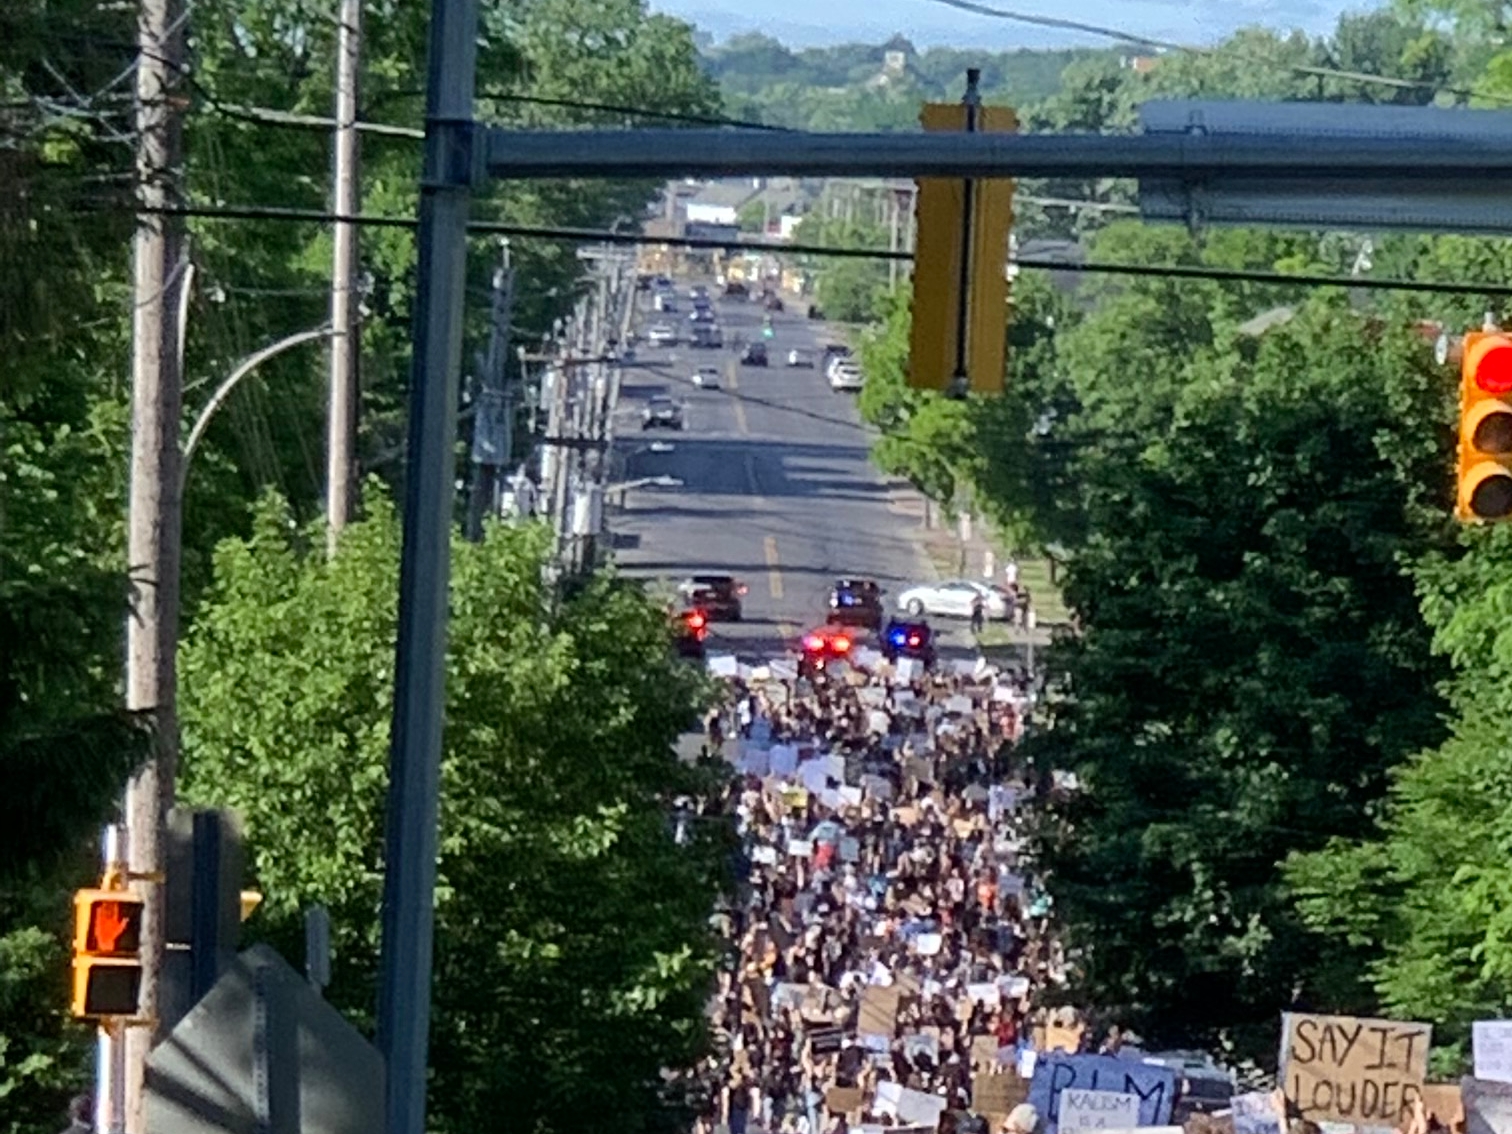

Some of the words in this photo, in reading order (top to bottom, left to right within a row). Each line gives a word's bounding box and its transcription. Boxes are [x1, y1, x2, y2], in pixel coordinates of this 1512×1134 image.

[1291, 1018, 1363, 1068] SAY
[1364, 1024, 1425, 1073] IT
[1292, 1073, 1423, 1122] LOUDER
